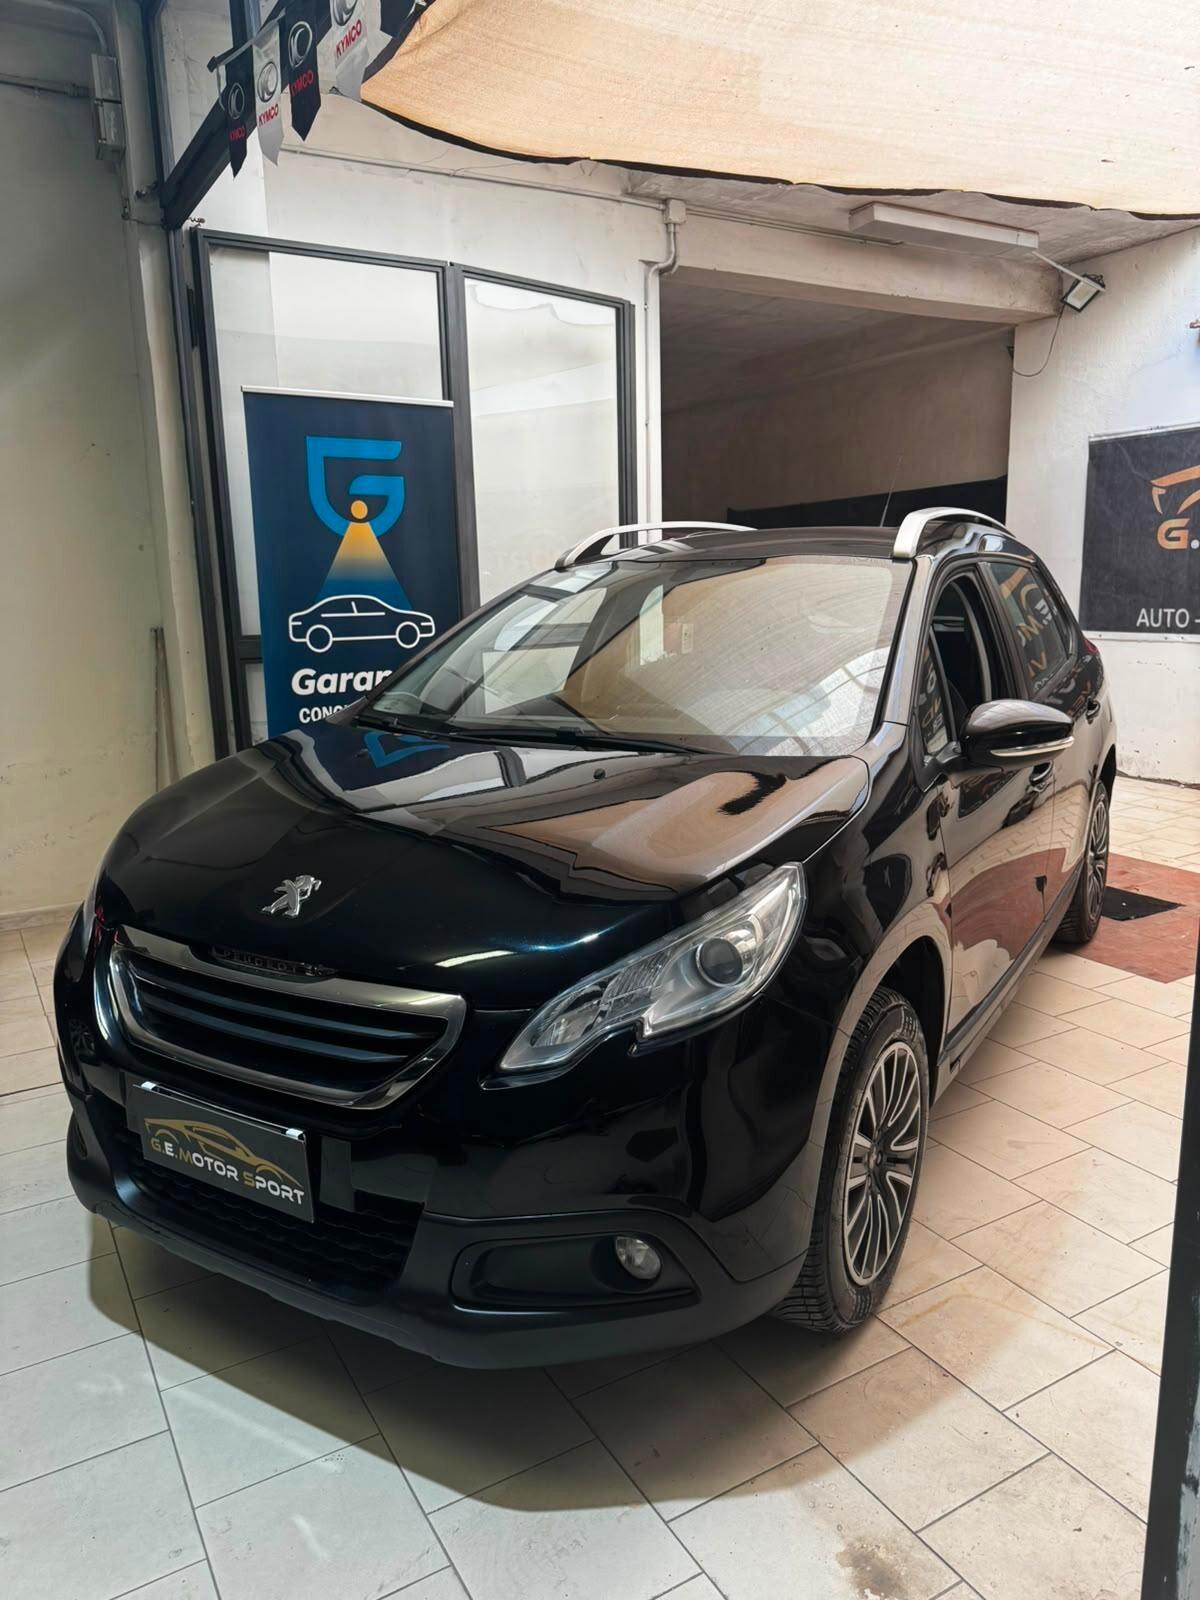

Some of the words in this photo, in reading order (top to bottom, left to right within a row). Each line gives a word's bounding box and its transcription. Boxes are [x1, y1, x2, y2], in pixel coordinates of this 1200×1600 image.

[335, 19, 362, 58] KYMCO
[290, 69, 314, 97] KYMCO
[258, 103, 279, 127] KYMCO
[1136, 607, 1190, 629] AUTO
[242, 1171, 305, 1205] SPORT
